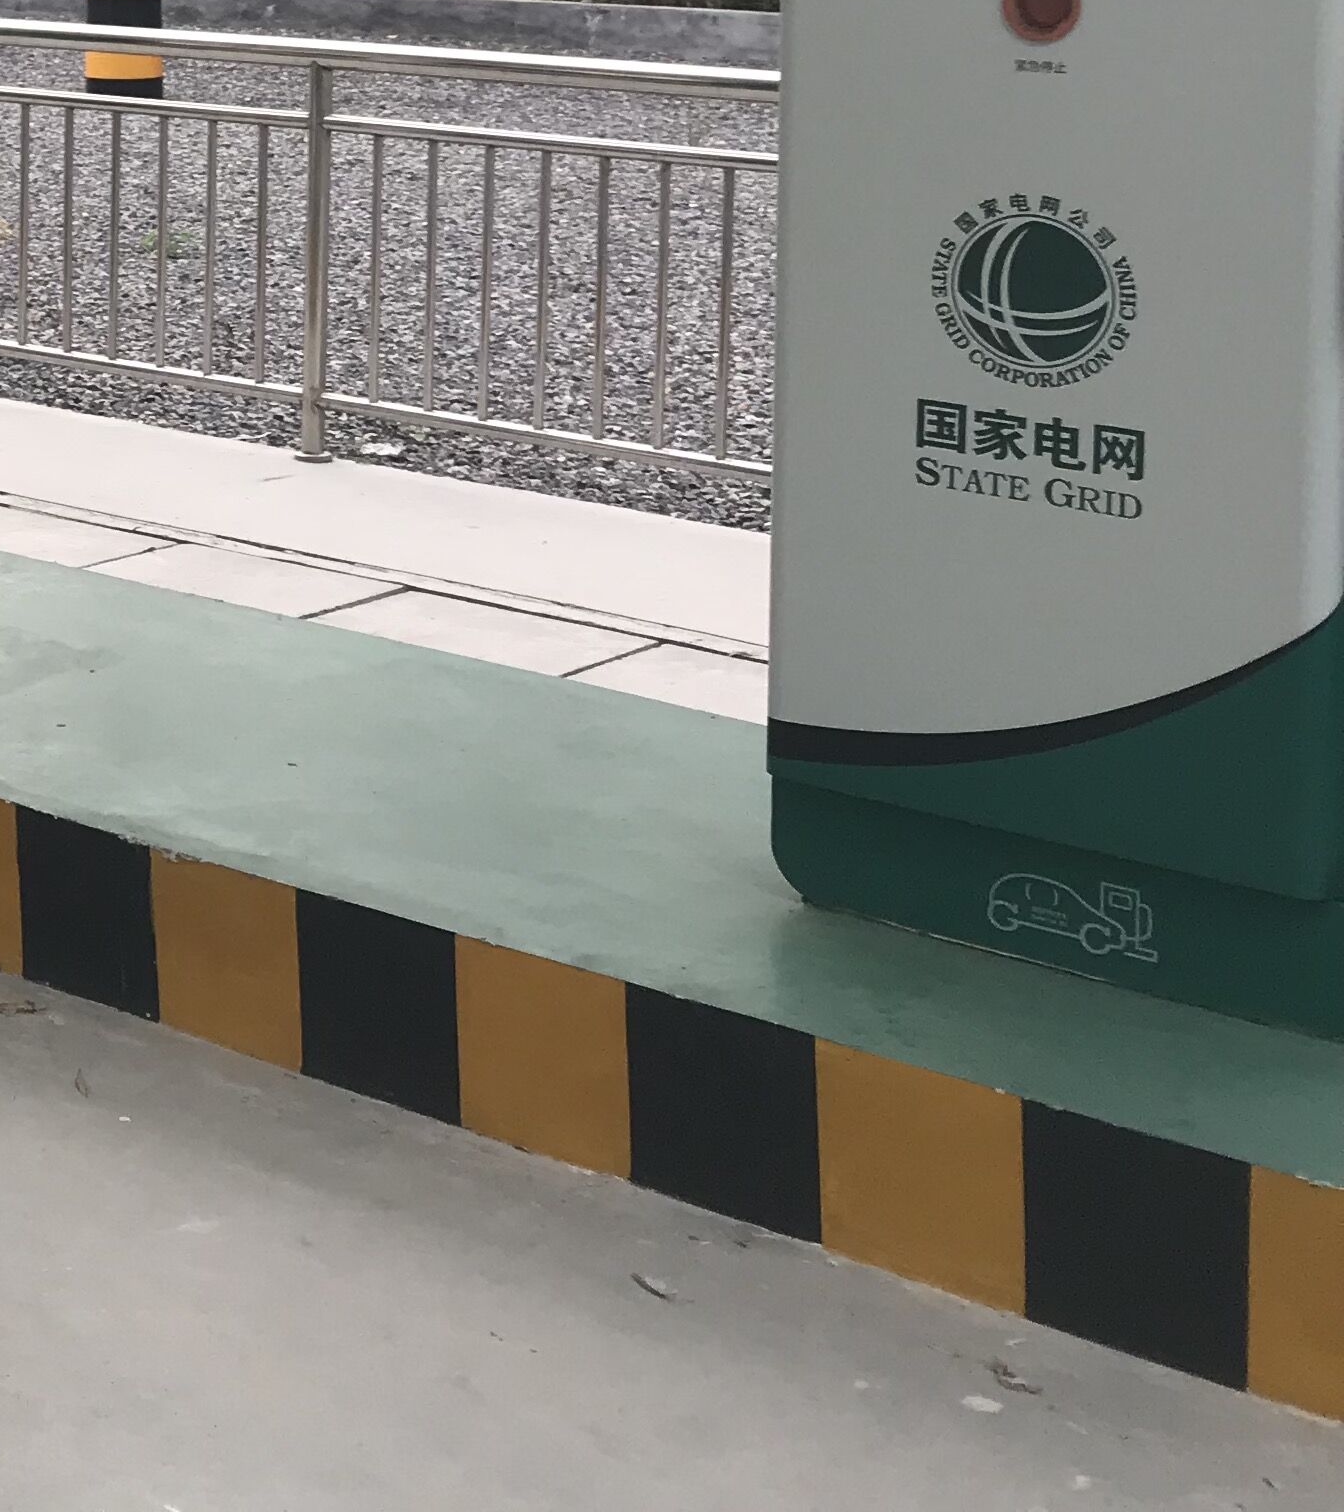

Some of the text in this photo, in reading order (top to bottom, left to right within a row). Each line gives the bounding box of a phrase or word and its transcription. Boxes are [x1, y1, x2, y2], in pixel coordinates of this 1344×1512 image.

[953, 193, 1117, 249] 国家电网公司
[931, 238, 1138, 388] STATE GRID CORPORATION OF CHINA
[915, 398, 1145, 481] 国家电网
[915, 457, 1143, 520] STATE GRID
